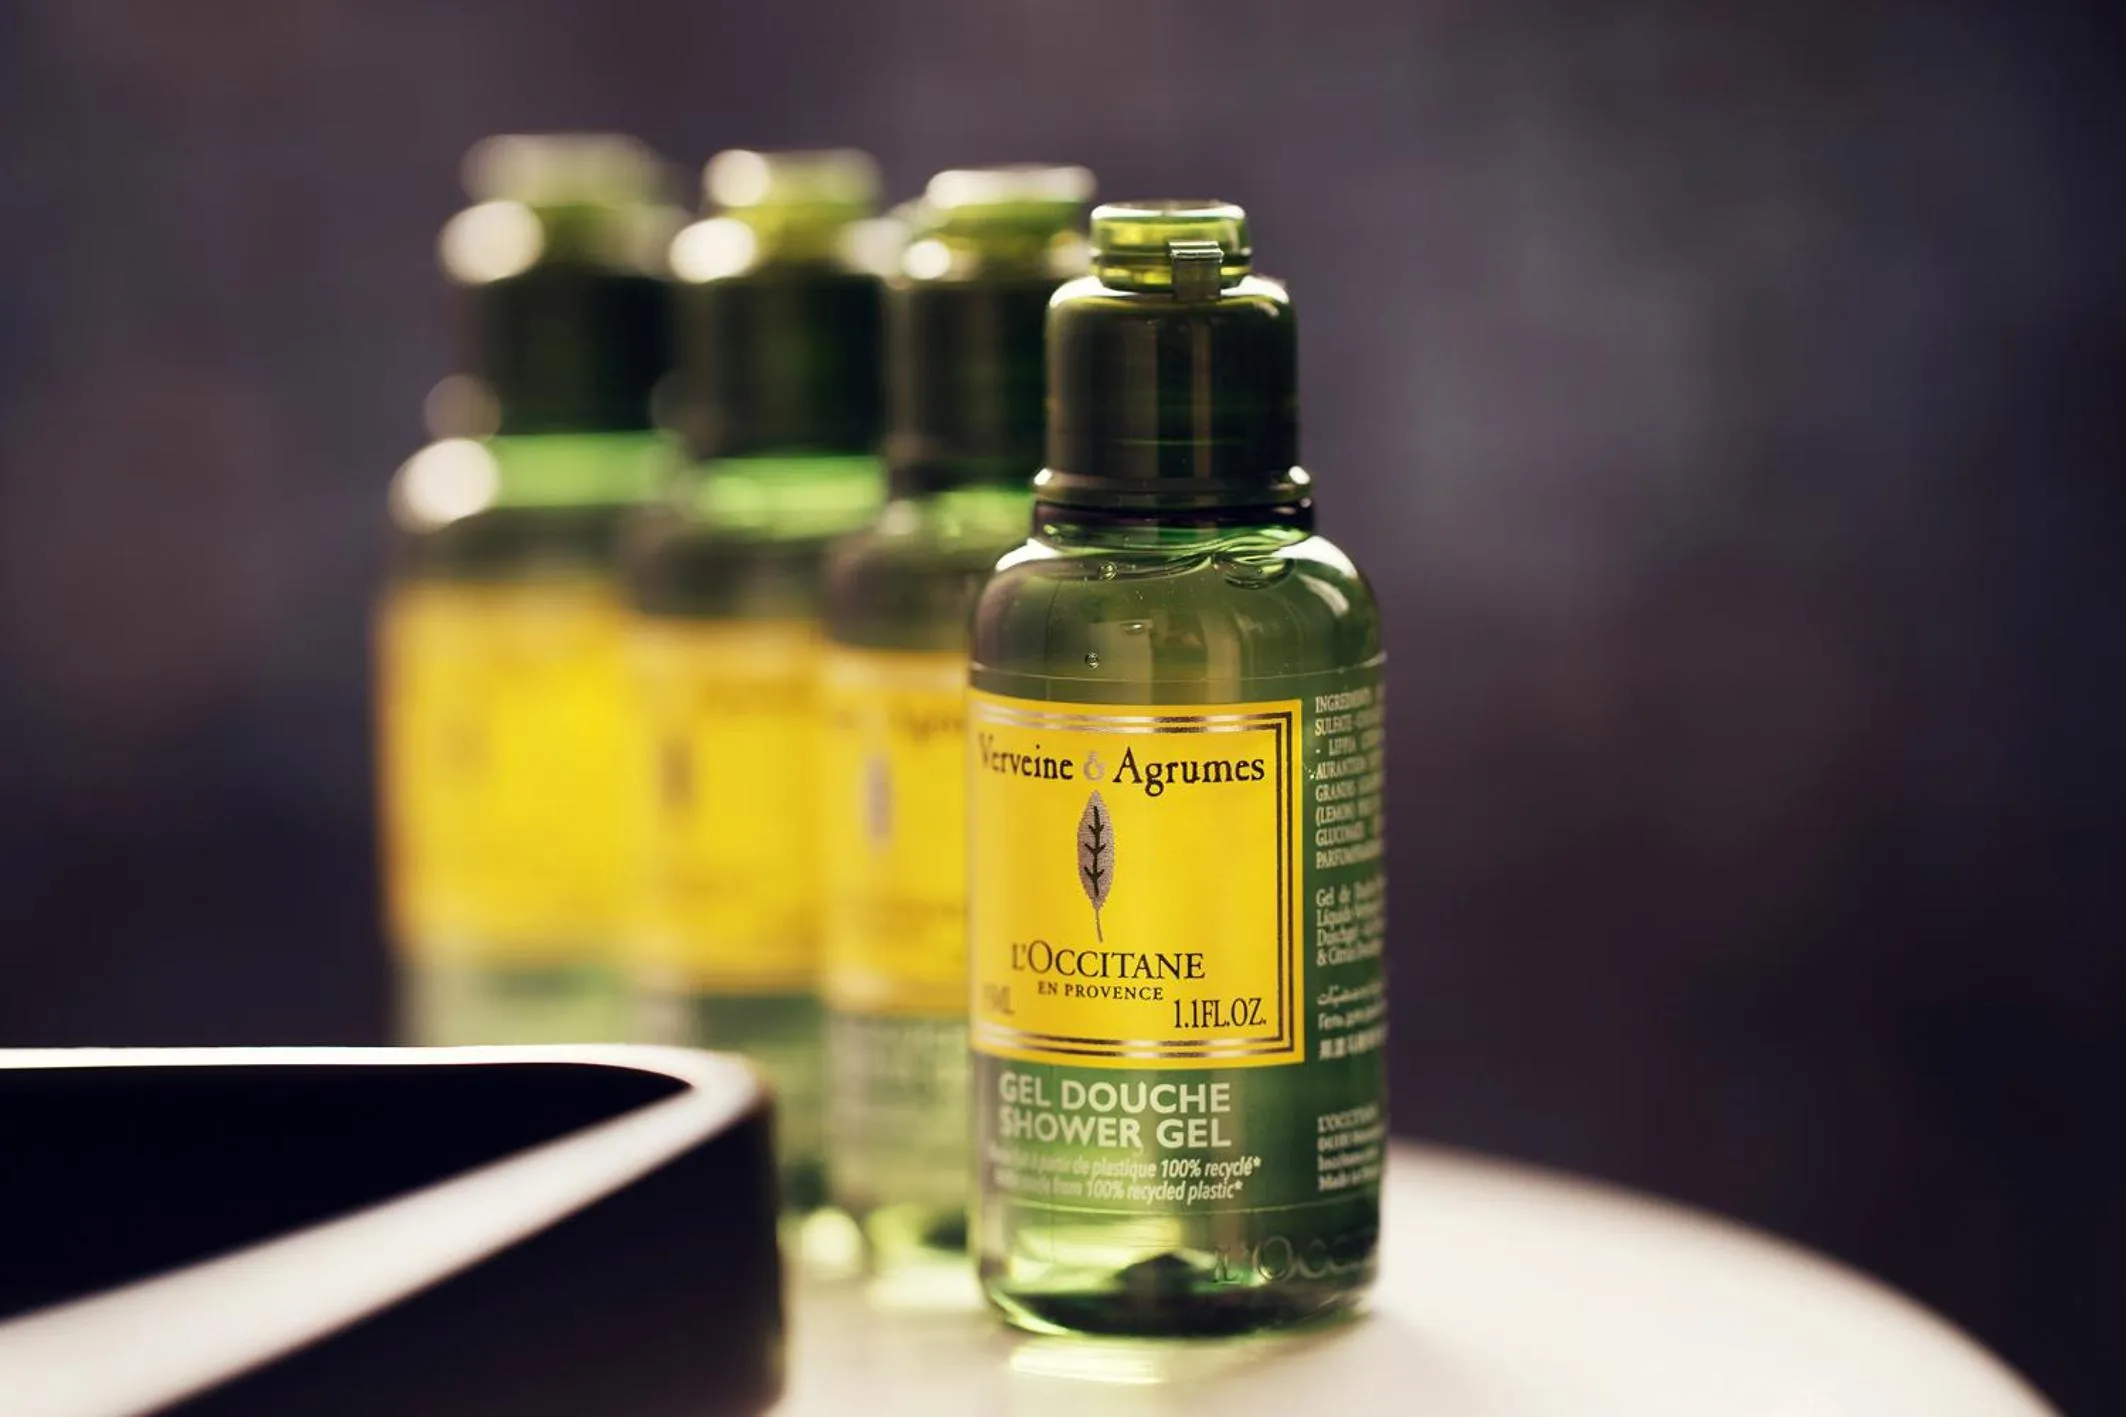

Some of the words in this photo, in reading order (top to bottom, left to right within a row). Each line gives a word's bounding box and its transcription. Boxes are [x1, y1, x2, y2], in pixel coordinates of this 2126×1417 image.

[979, 732, 1073, 781] Verveine
[1112, 746, 1265, 797] Agrumes
[1011, 940, 1206, 980] L'OCCITANE
[1038, 981, 1058, 995] EN
[1065, 983, 1164, 1001] PROVENCE
[1000, 1070, 1052, 1107] GEL
[1061, 1079, 1231, 1114] DOUCHE
[1000, 1106, 1143, 1148] SHOWER
[1156, 1118, 1232, 1149] GEL
[1092, 1157, 1157, 1182] plastique
[1161, 1158, 1202, 1179] 100%
[1087, 1179, 1125, 1199] 100%
[1127, 1180, 1187, 1205] recycled
